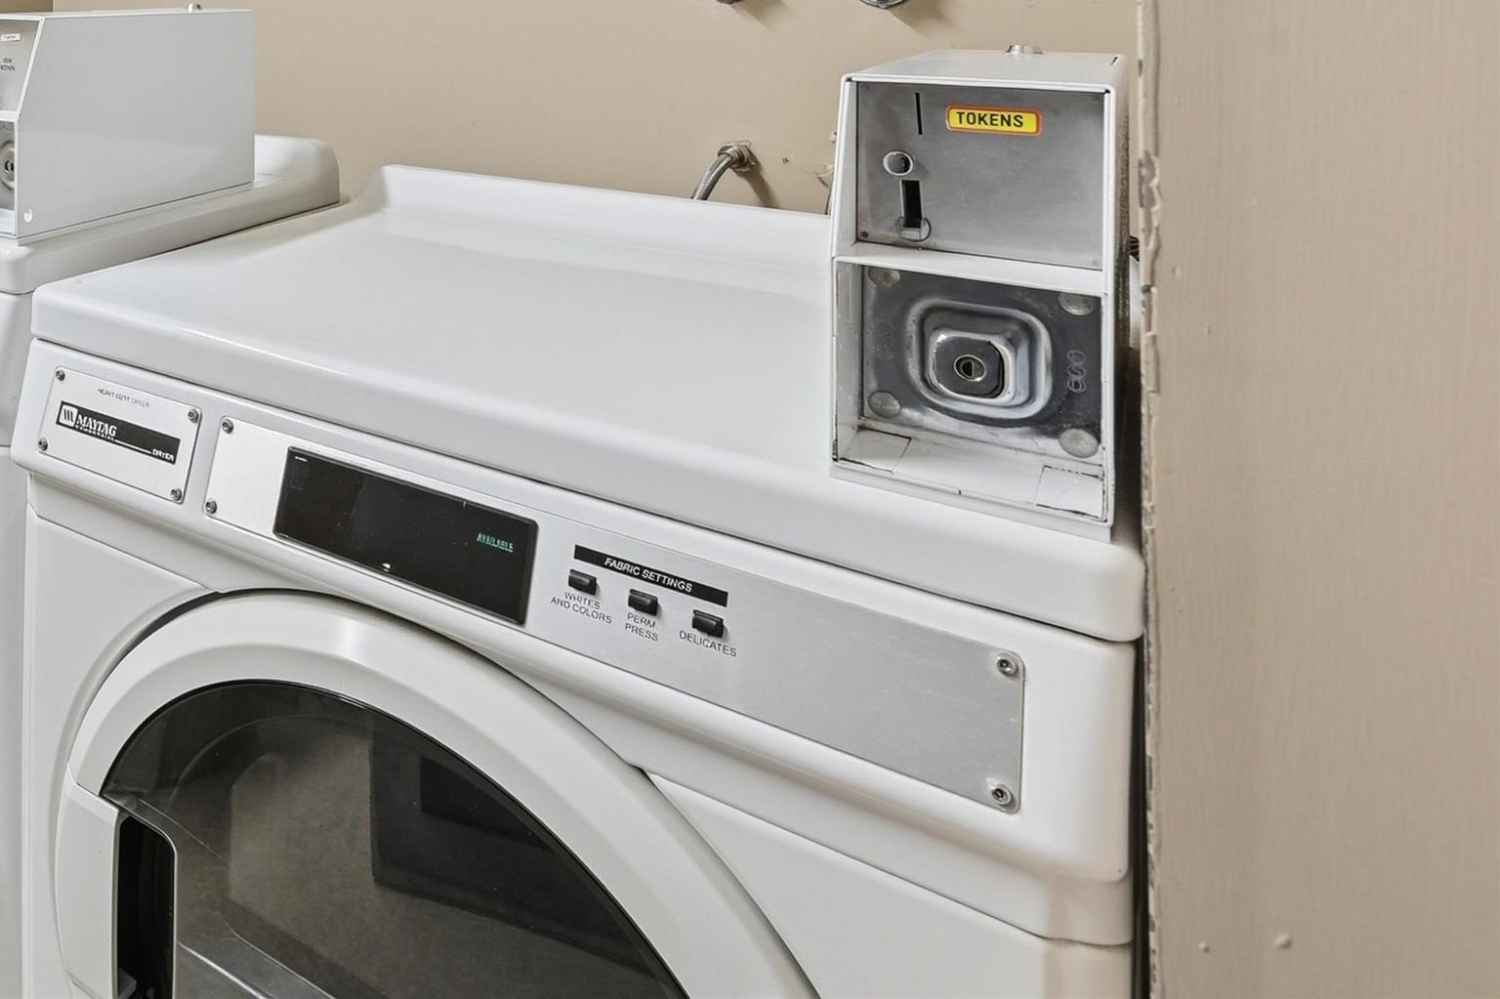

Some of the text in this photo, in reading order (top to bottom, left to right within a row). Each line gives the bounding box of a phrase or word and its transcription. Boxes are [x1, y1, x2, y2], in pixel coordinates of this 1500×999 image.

[956, 111, 1024, 128] TOKENS
[77, 414, 117, 437] MAYTAG
[604, 557, 693, 593] FABRIC SETTINGS
[550, 596, 612, 624] AND COLORS
[563, 591, 600, 610] WHITES
[625, 622, 659, 641] PRESS
[679, 630, 738, 657] DELICATES
